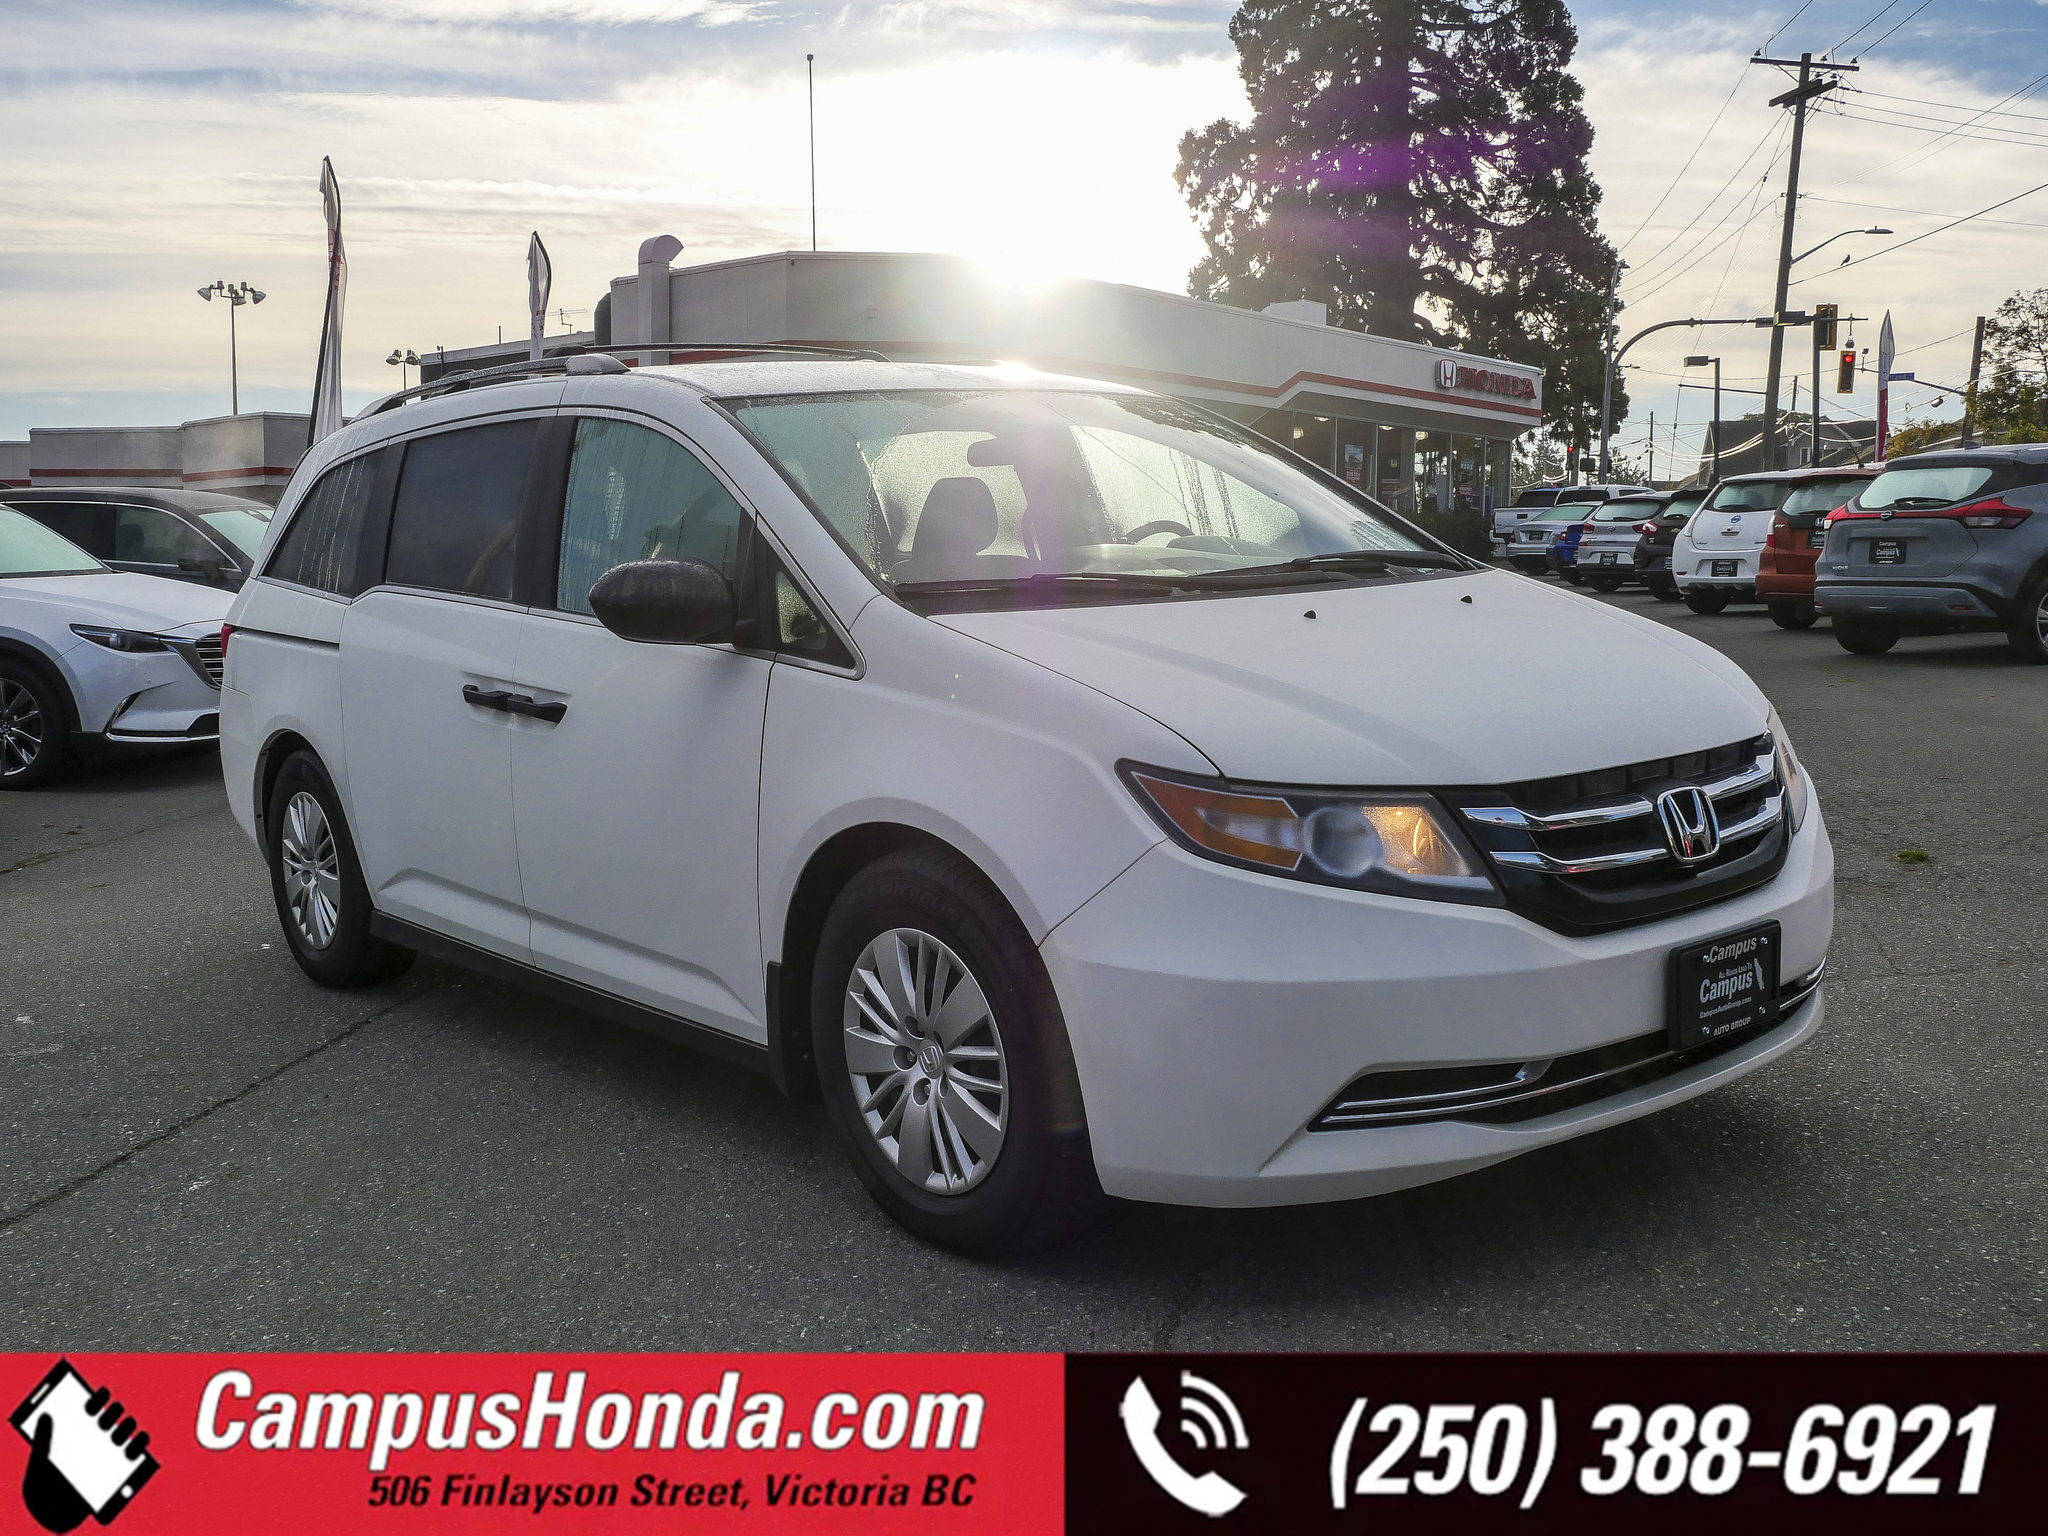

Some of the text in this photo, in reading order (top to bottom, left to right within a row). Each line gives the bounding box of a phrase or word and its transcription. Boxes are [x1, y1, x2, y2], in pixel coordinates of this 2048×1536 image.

[1460, 366, 1537, 399] HONDA
[1709, 937, 1757, 963] Campus
[1700, 971, 1753, 1004] Campus
[1713, 1016, 1751, 1037] AUTO GROUP
